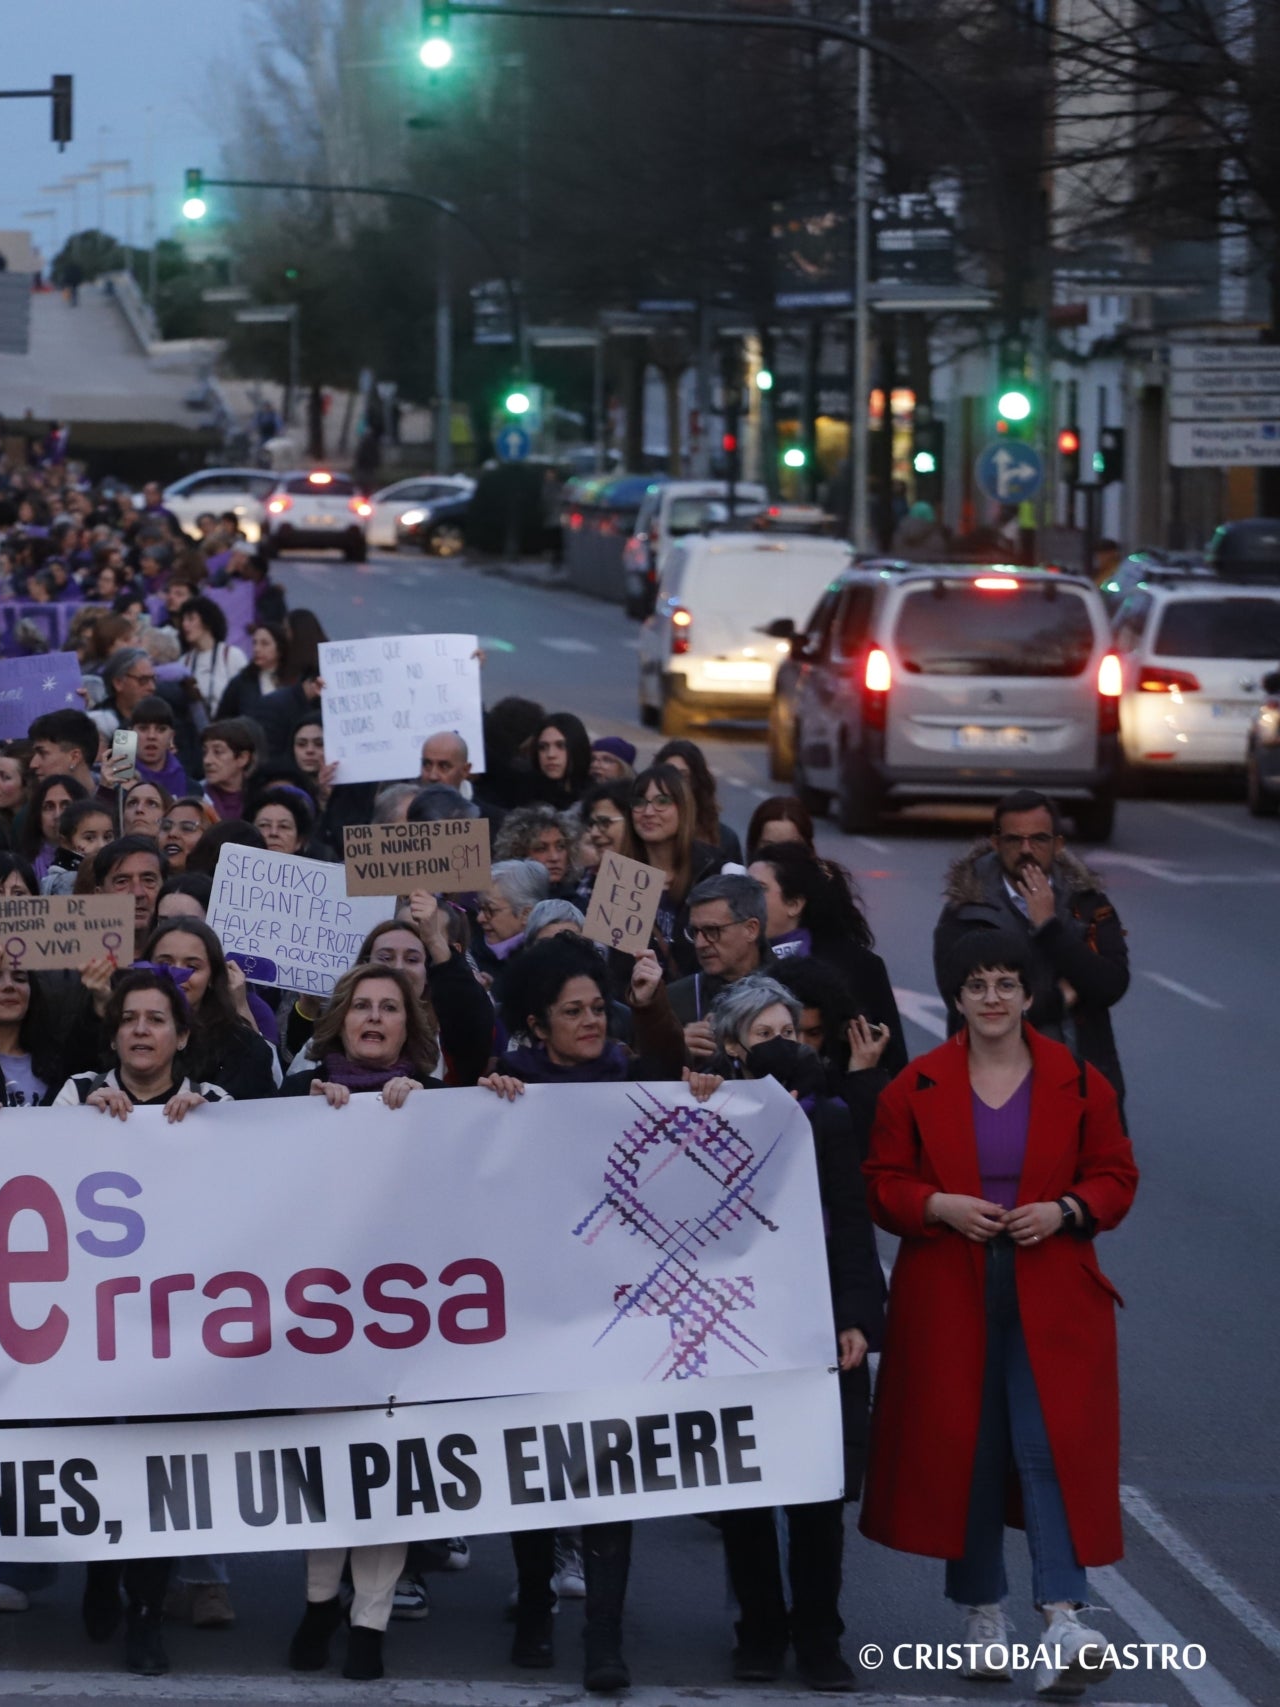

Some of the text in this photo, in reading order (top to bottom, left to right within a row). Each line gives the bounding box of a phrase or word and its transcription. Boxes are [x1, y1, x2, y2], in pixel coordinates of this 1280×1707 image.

[381, 642, 401, 661] QUE
[406, 663, 424, 680] NO
[346, 821, 471, 841] POR TODAS LAS
[346, 837, 432, 858] QUE NUNCA
[227, 853, 327, 897] SEGUEIXO
[354, 857, 450, 880] VOLVIERON
[67, 899, 86, 916] DE
[219, 880, 352, 925] FLIPANT PER
[53, 920, 76, 933] QUE
[212, 908, 282, 940] HAVER
[290, 923, 310, 947] DE
[35, 939, 81, 956] VIVA
[222, 932, 349, 970] PER AQUESTA
[277, 965, 337, 993] MERD
[145, 1453, 214, 1533] NI
[235, 1446, 328, 1527] UN
[349, 1433, 483, 1521] PAS
[503, 1405, 763, 1506] ENRERE
